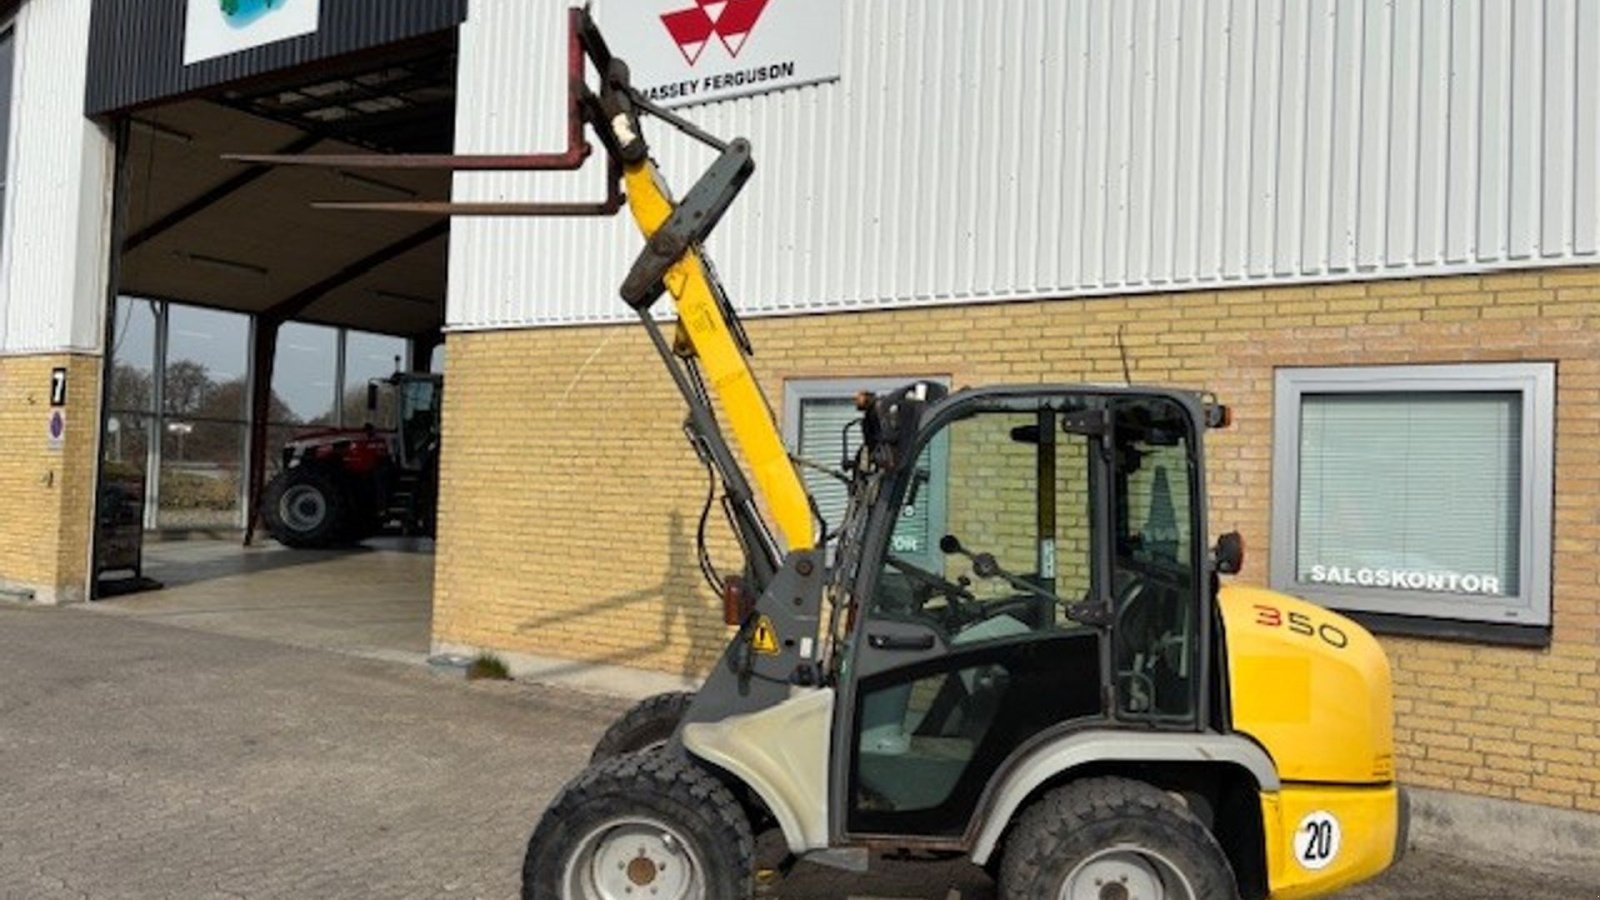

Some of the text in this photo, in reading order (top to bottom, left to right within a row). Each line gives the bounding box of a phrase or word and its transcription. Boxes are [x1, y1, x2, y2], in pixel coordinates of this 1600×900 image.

[703, 61, 794, 90] FERGUSON
[53, 371, 65, 402] 7
[1310, 564, 1500, 594] SALGSKONTOR
[1253, 603, 1348, 649] 350
[1304, 819, 1332, 860] 20
